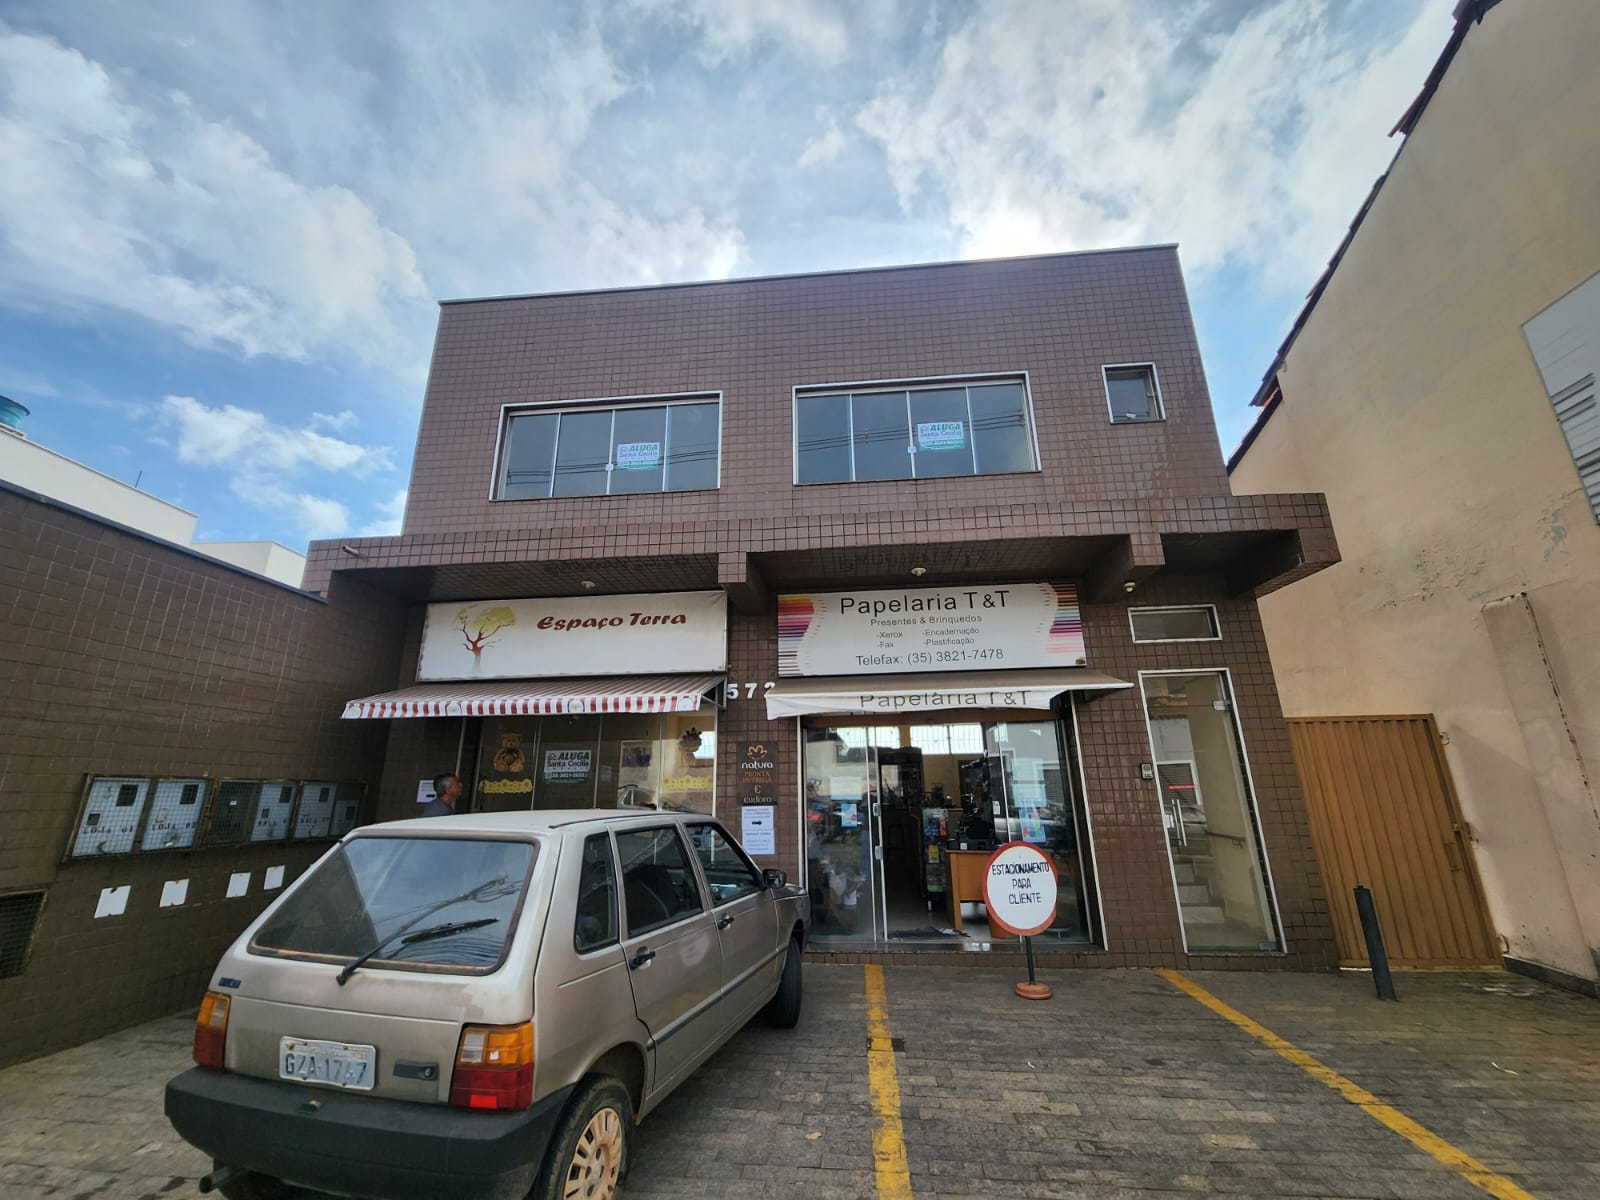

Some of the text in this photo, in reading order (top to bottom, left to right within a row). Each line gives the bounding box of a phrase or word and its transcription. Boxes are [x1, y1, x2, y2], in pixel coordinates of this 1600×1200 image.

[840, 590, 1010, 618] Papelaria T&T
[536, 612, 687, 632] Espaço Terra
[870, 614, 982, 627] Presentes & Brinquedos
[856, 648, 1004, 666] Telefax: (35) 3821-7478
[860, 692, 977, 710] Papelaria
[558, 752, 590, 760] ALUGA
[547, 760, 566, 768] Santa
[742, 760, 774, 770] natura
[992, 862, 1050, 876] ESTACIONAMENTO
[1012, 878, 1032, 889] PARA
[1008, 892, 1042, 904] CLIENTE
